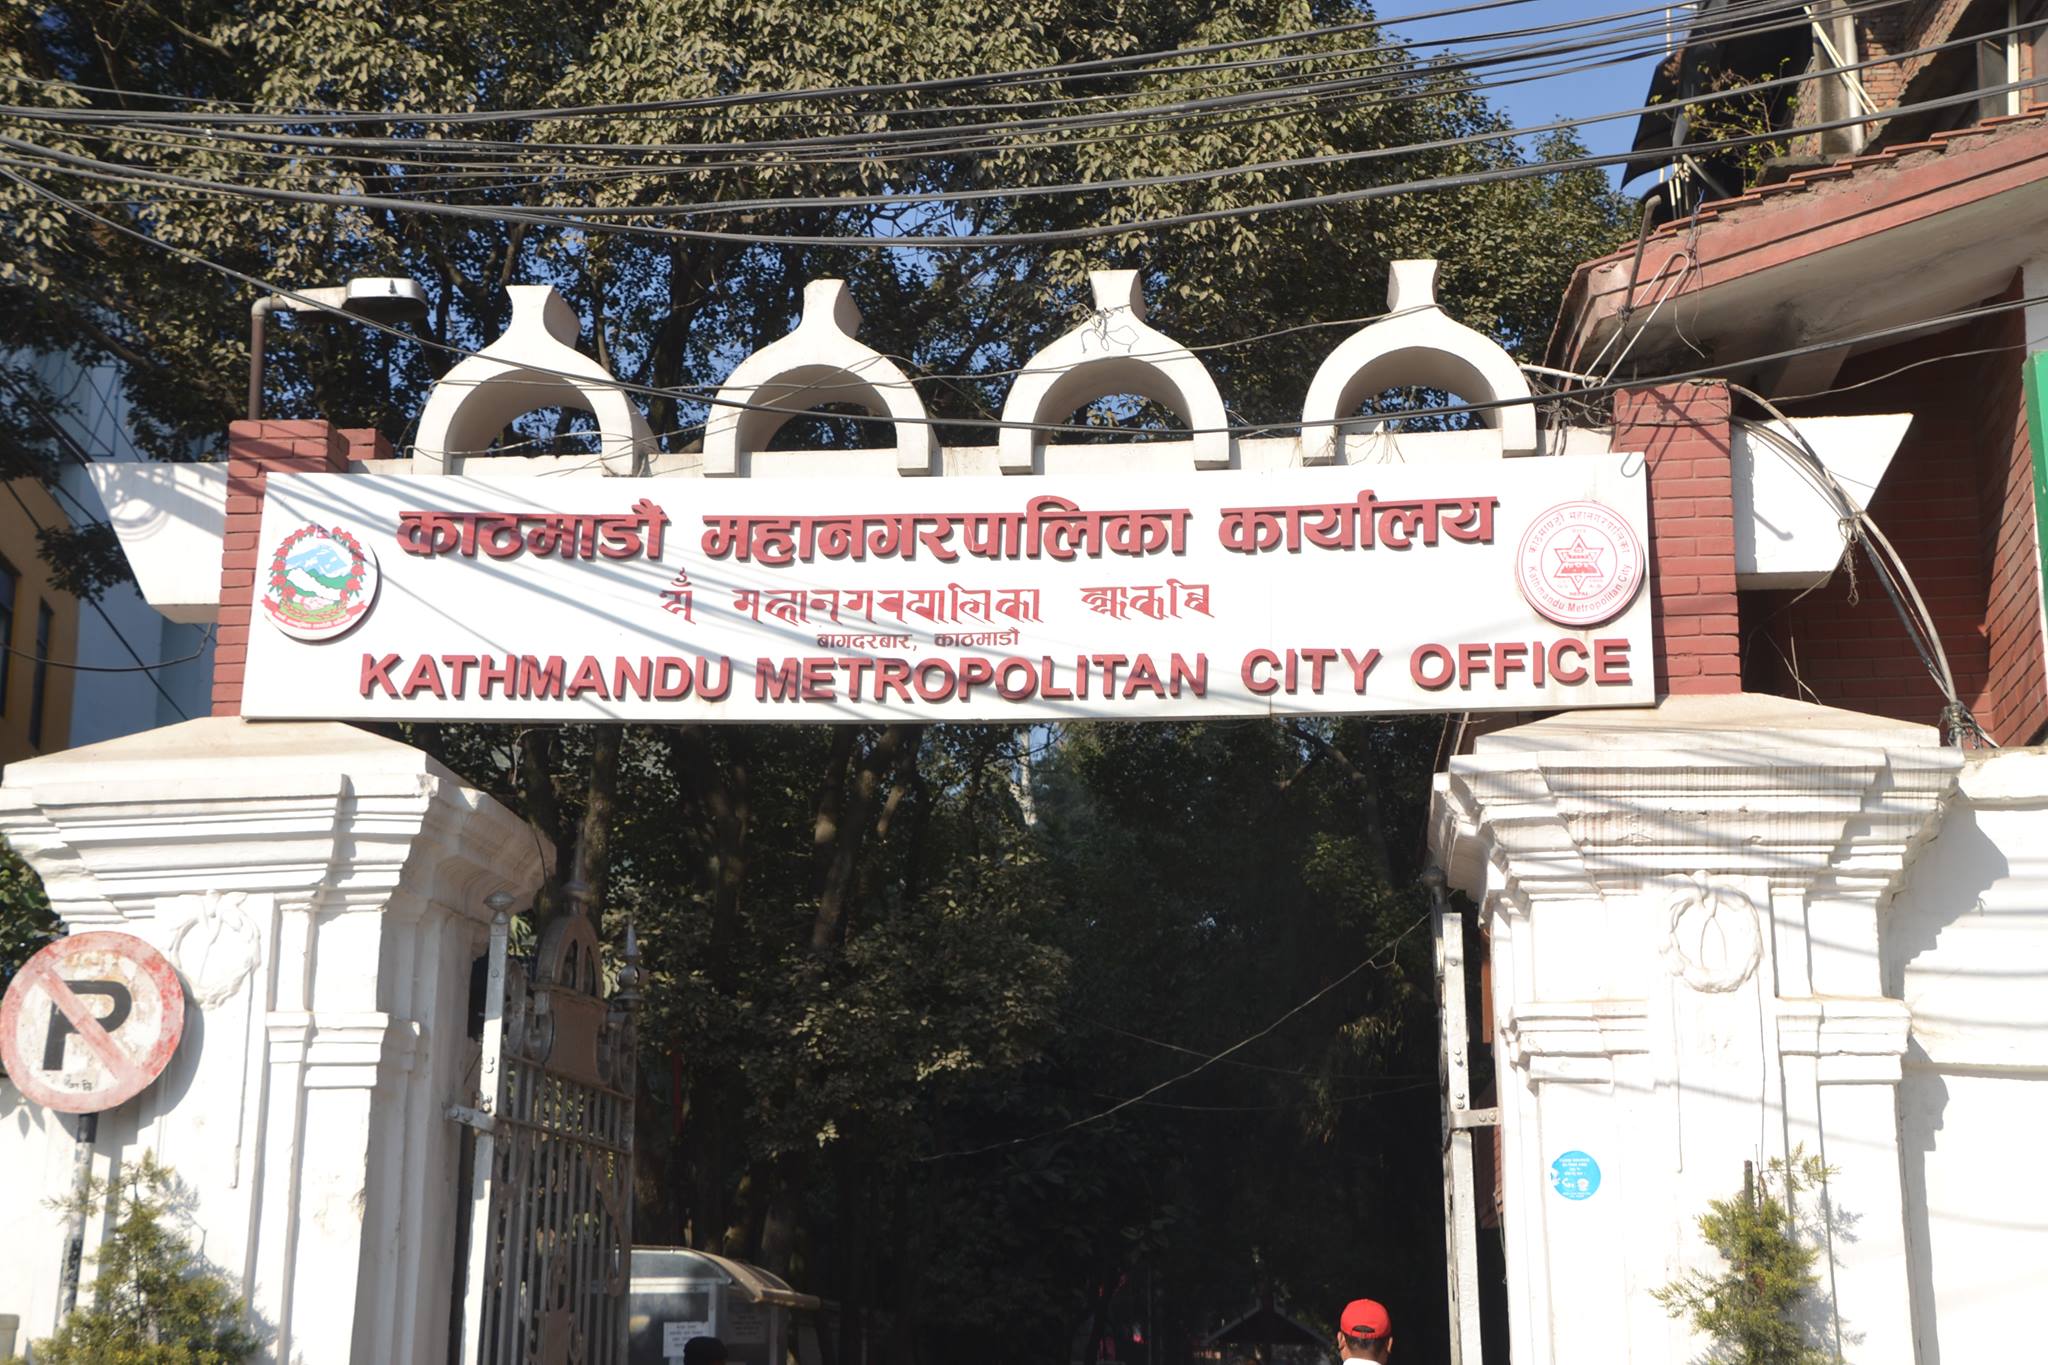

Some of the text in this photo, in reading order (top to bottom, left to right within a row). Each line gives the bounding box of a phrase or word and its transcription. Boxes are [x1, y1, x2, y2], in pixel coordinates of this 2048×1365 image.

[700, 495, 1192, 565] महानगरपालिका
[1218, 489, 1498, 553] कार्यालय
[360, 637, 1632, 702] KATHMANDU METROPOLITAN CITY OFFICE
